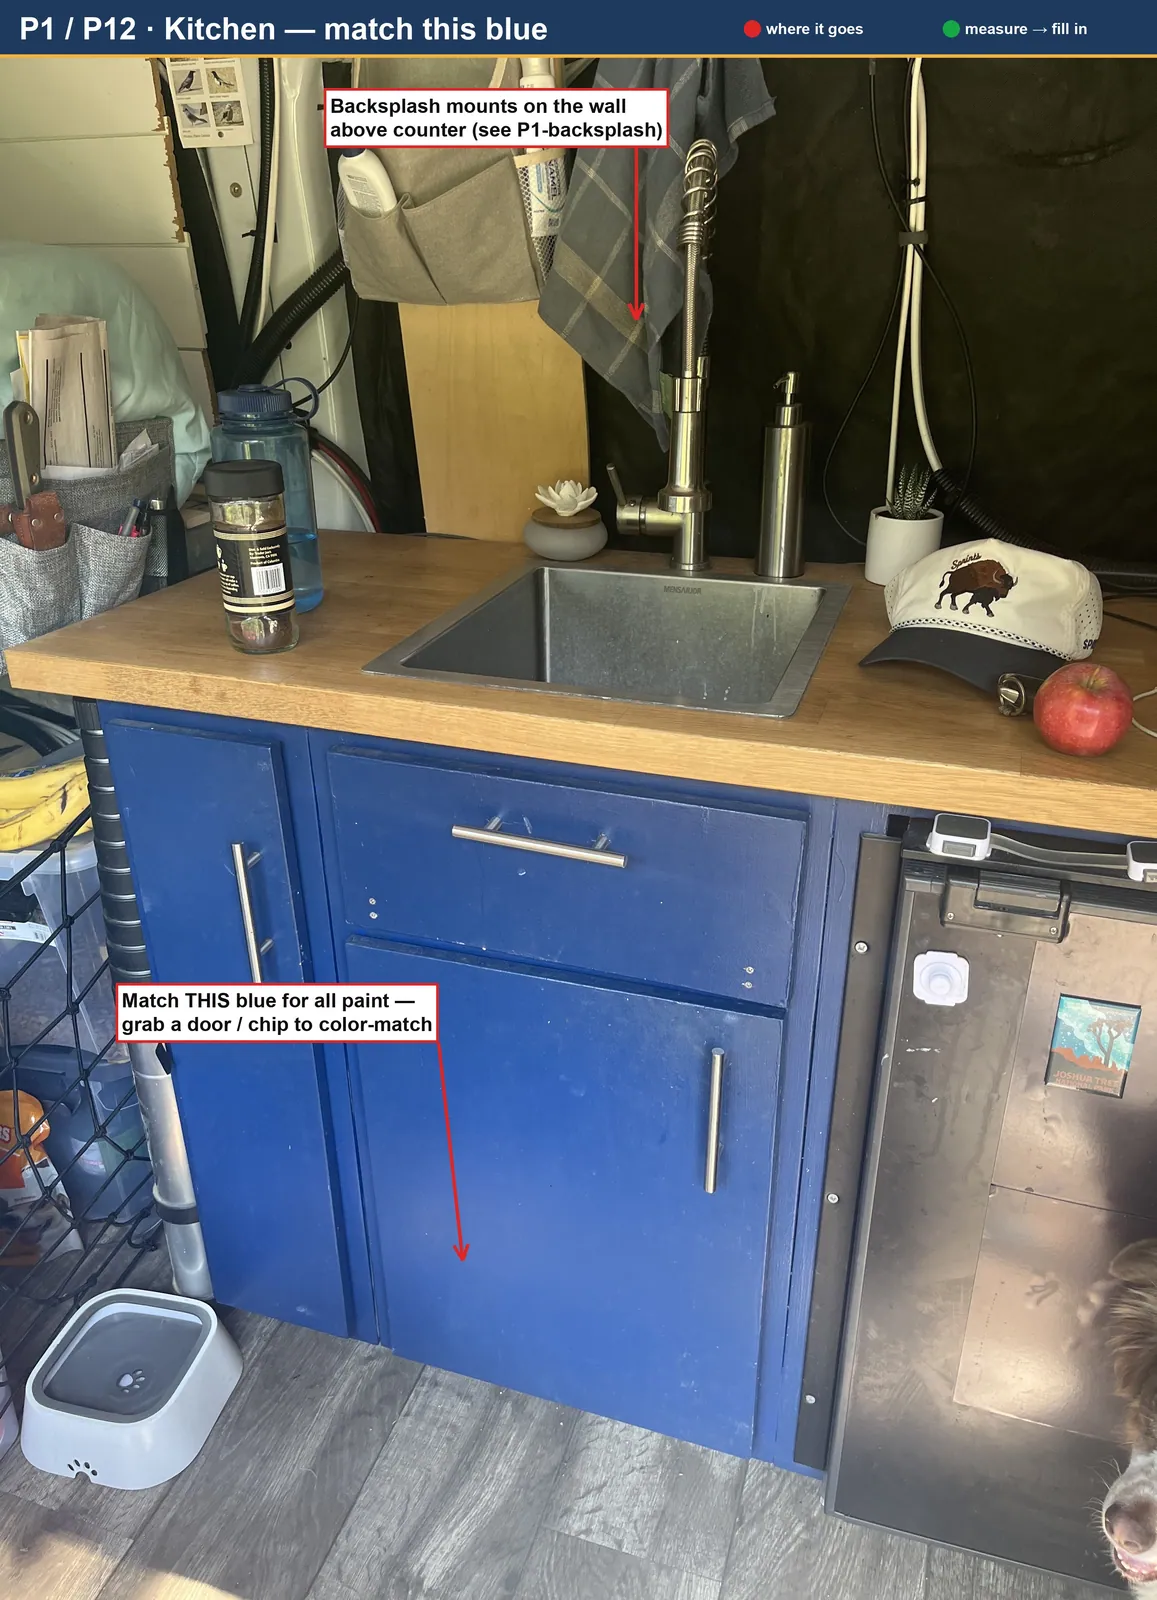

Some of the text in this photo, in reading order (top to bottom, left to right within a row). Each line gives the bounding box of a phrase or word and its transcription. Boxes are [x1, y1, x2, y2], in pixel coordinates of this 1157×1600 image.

[951, 552, 982, 570] Sprints
[1054, 1071, 1119, 1088] JOSHUA TREE
